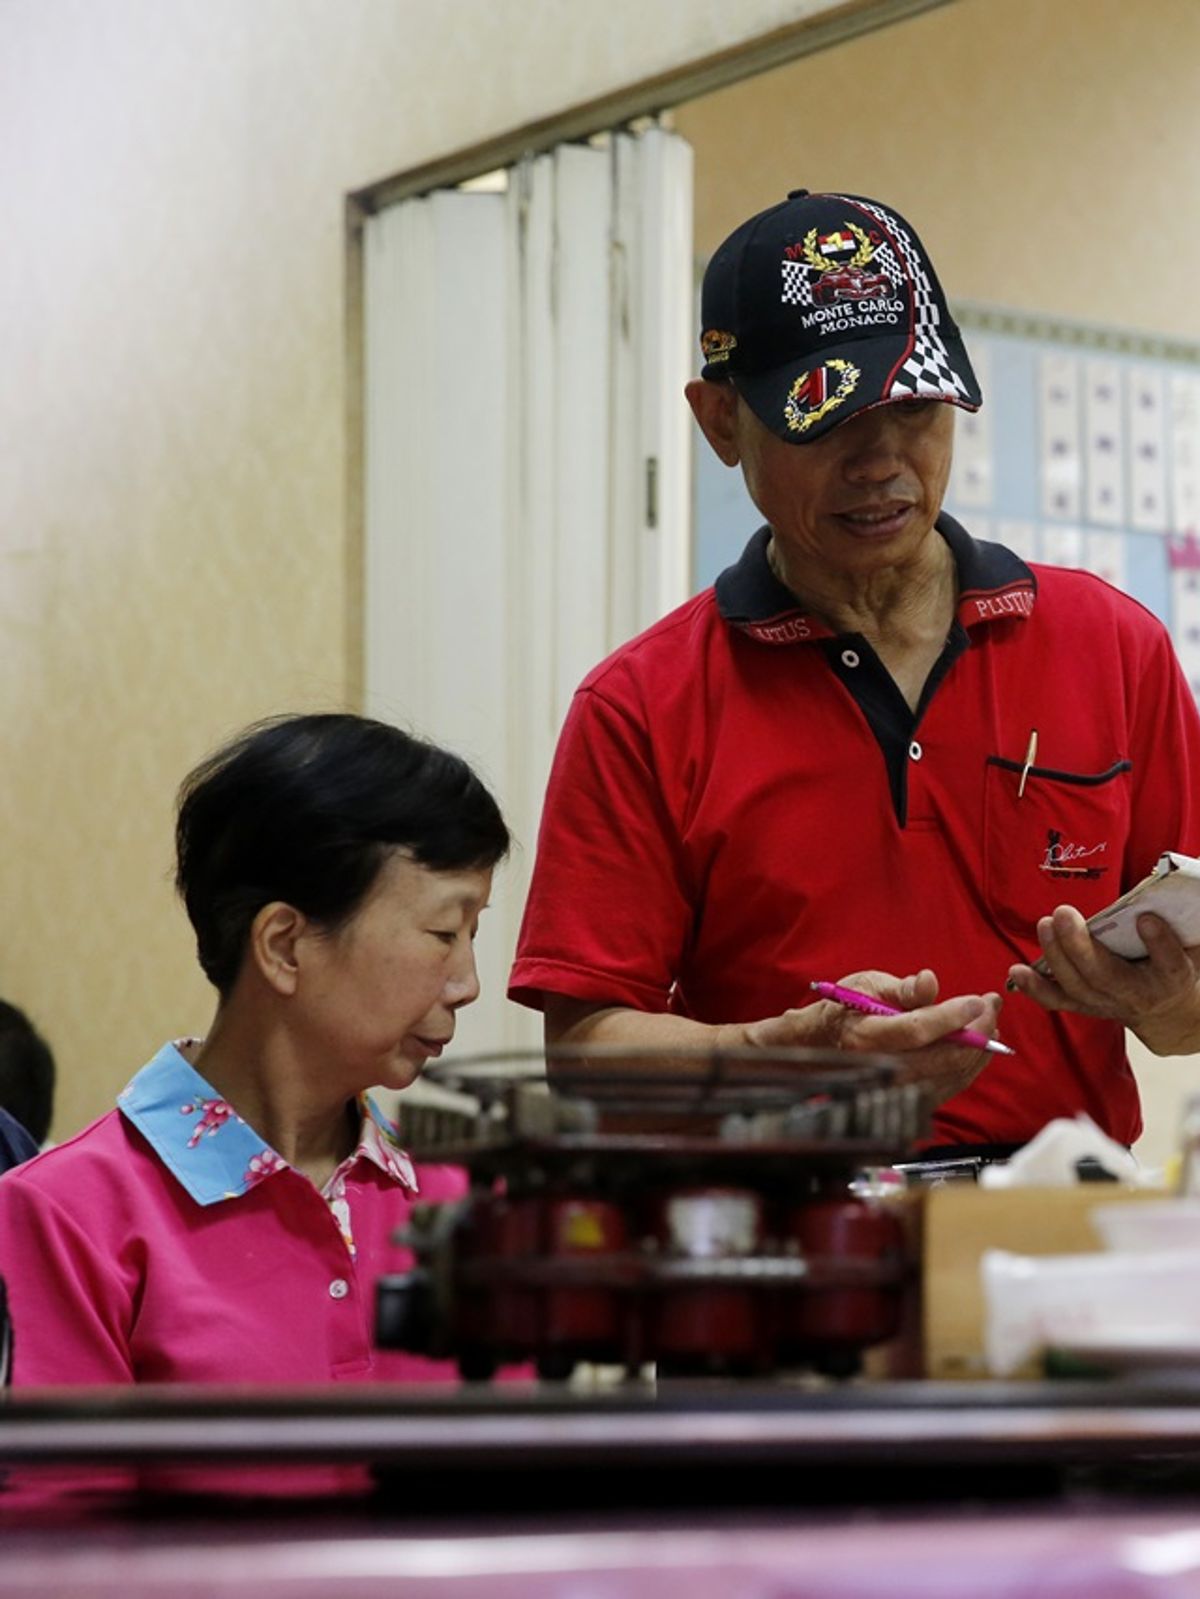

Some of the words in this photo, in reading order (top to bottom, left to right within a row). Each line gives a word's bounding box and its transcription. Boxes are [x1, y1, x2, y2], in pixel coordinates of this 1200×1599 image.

[801, 302, 854, 329] MONTE
[858, 299, 904, 312] CARLO
[820, 313, 898, 335] MONACO
